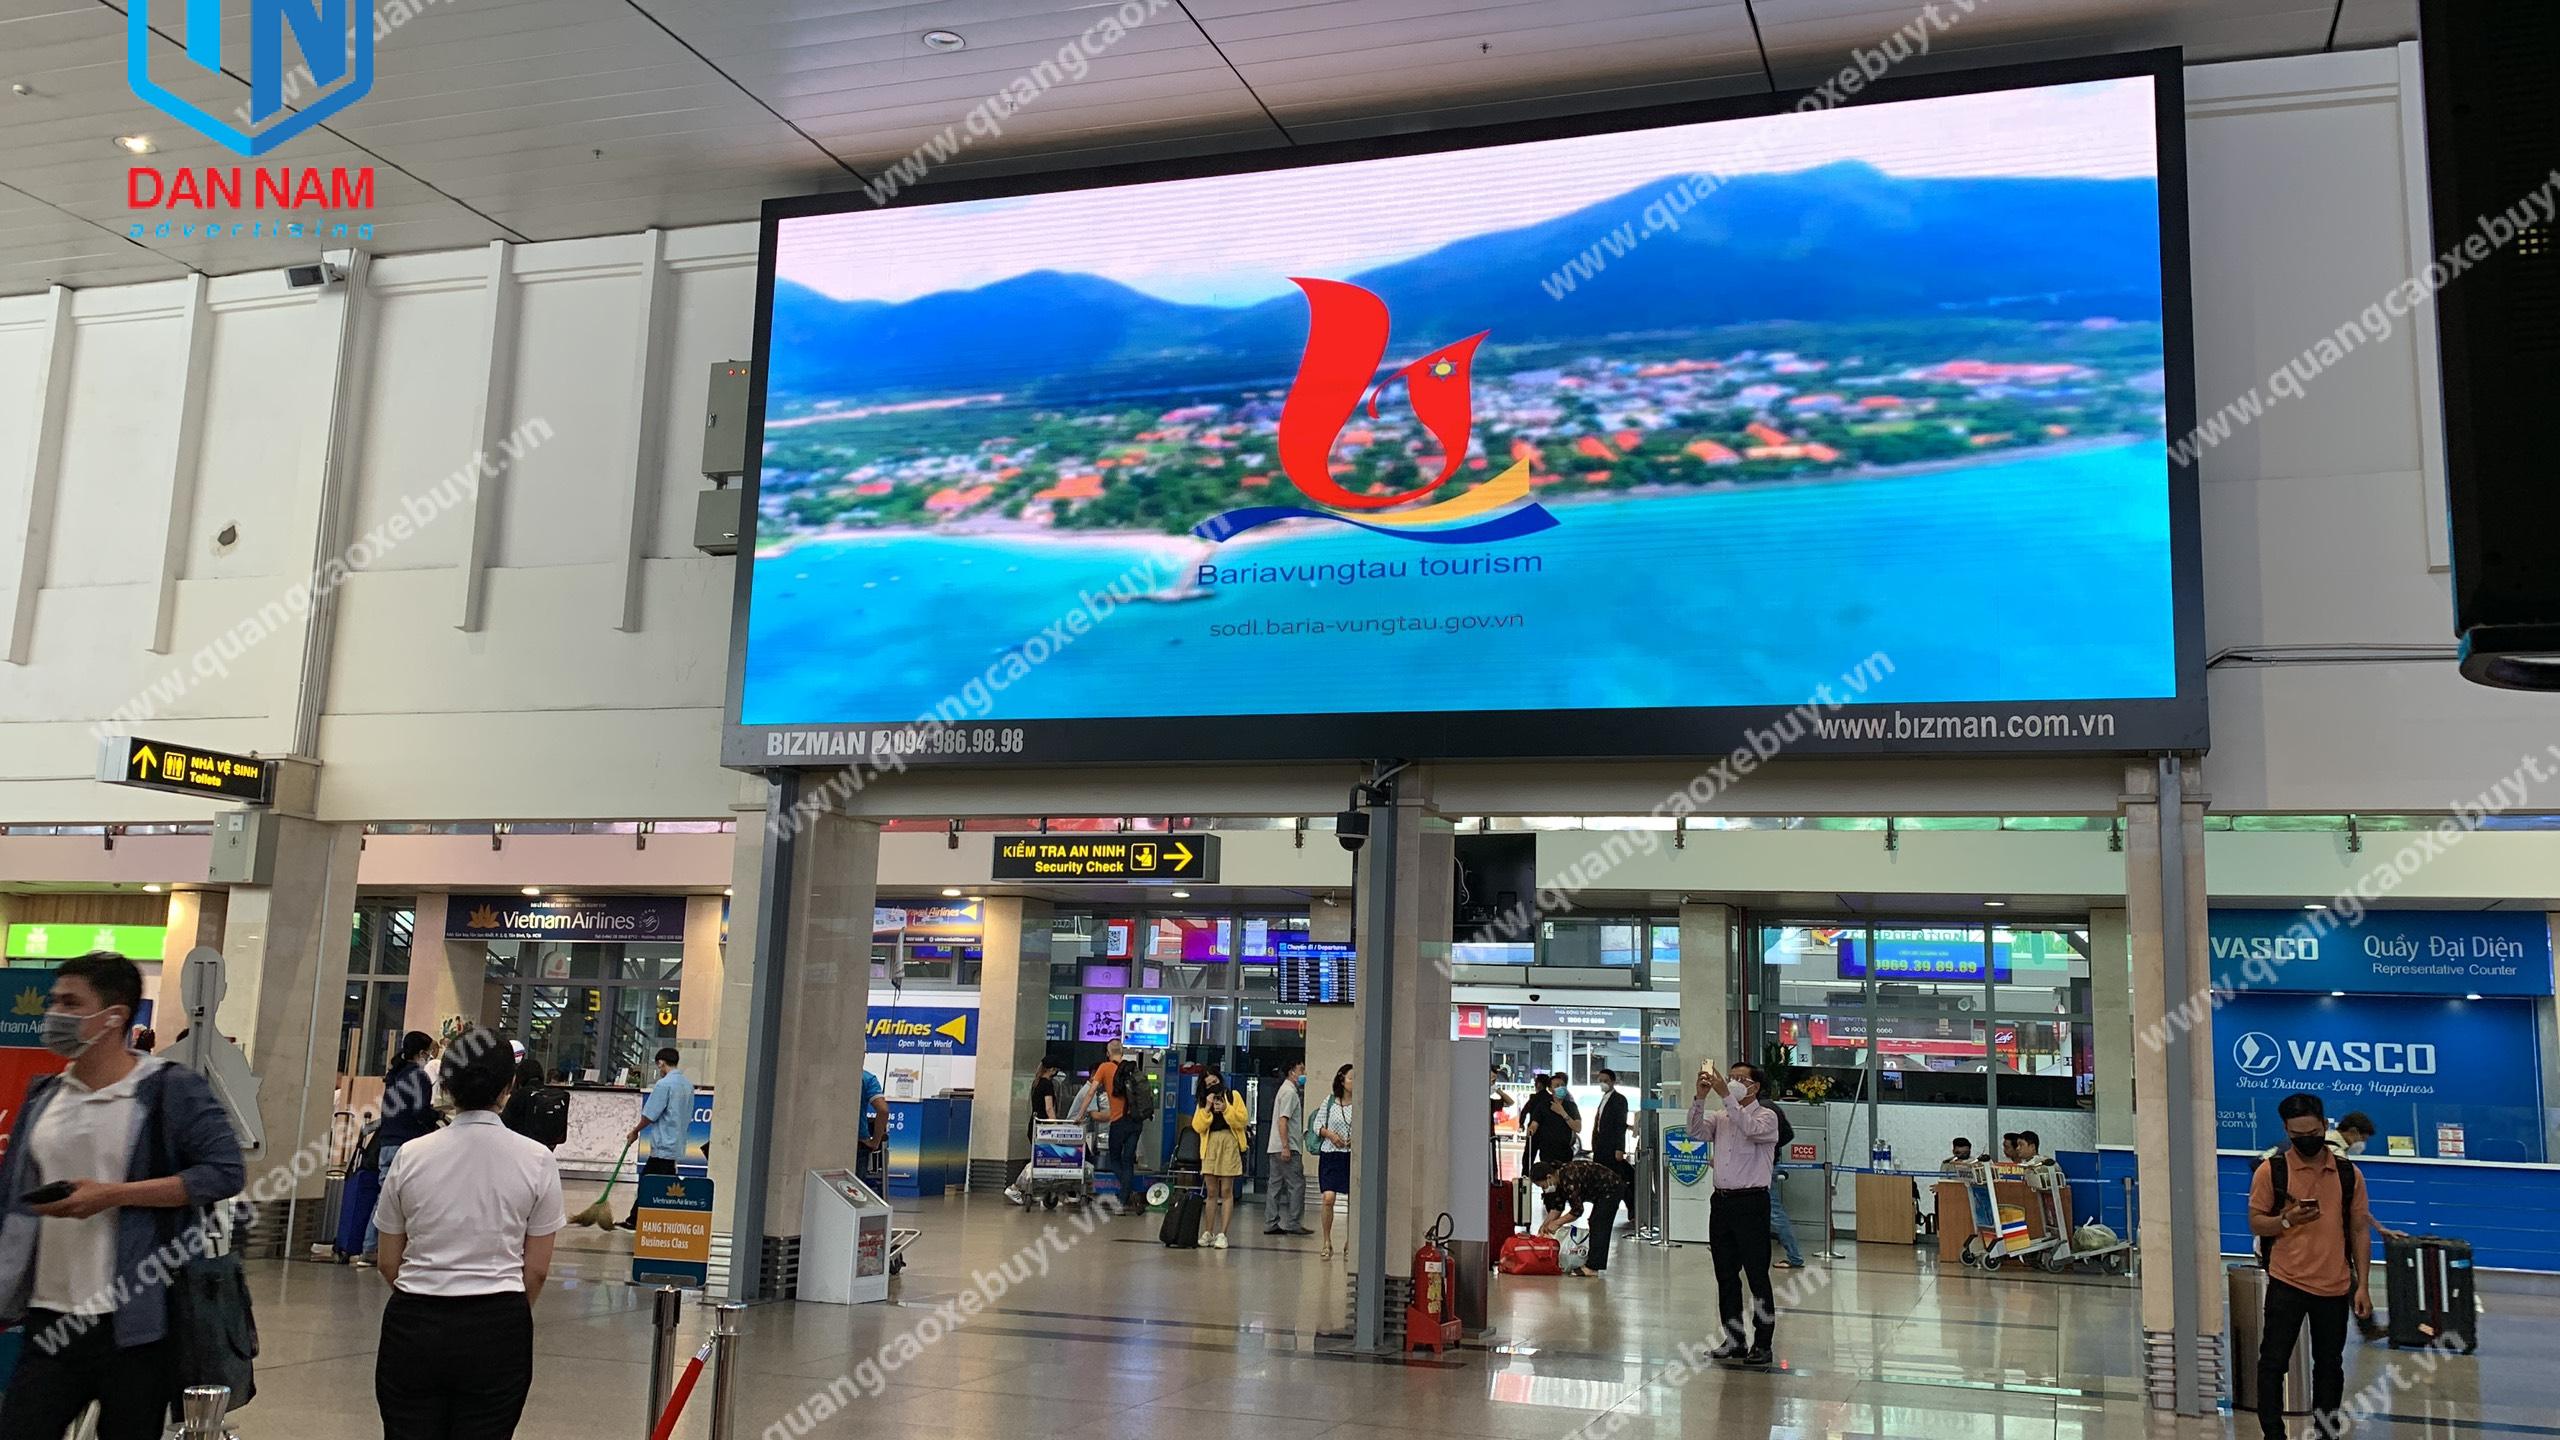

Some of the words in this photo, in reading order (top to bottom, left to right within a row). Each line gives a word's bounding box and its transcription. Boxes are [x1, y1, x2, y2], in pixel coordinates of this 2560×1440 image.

[1198, 559, 1407, 586] Bariavungtau
[1420, 553, 1543, 577] tourism
[1209, 613, 1525, 637] sodl.baria-vungtau.gov.vn
[1817, 711, 2115, 742] www.bizman.com.vn
[767, 731, 866, 756] BIZMAN
[894, 728, 1024, 755] 094.986.98.98
[190, 756, 215, 771] NHÀ
[217, 759, 231, 776] VỆ
[233, 764, 259, 779] SINH
[190, 771, 222, 787] Toilets
[1003, 840, 1036, 858] KIỂM
[1040, 845, 1067, 858] TRA
[1070, 845, 1089, 858] AN
[1092, 845, 1126, 858] NINH
[1034, 861, 1083, 875] Security
[1086, 861, 1124, 872] Check
[2210, 937, 2319, 961] VASCO
[2364, 933, 2419, 962] Quầy
[2429, 936, 2465, 961] Đại
[2472, 935, 2524, 963] Diện
[2372, 962, 2464, 977] Representative
[2469, 964, 2517, 976] Counter
[872, 1018, 932, 1037] Airlines
[898, 1039, 915, 1048] Open
[917, 1039, 931, 1048] Your
[933, 1039, 953, 1049] World
[2287, 1040, 2437, 1075] VASCO
[2236, 1076, 2269, 1090] Short
[2368, 1081, 2435, 1096] Happiness
[2217, 1111, 2235, 1119] 320
[1793, 1146, 1814, 1154] PCCC
[692, 1224, 705, 1235] GIA
[641, 1235, 670, 1248] Business
[671, 1237, 688, 1249] Class
